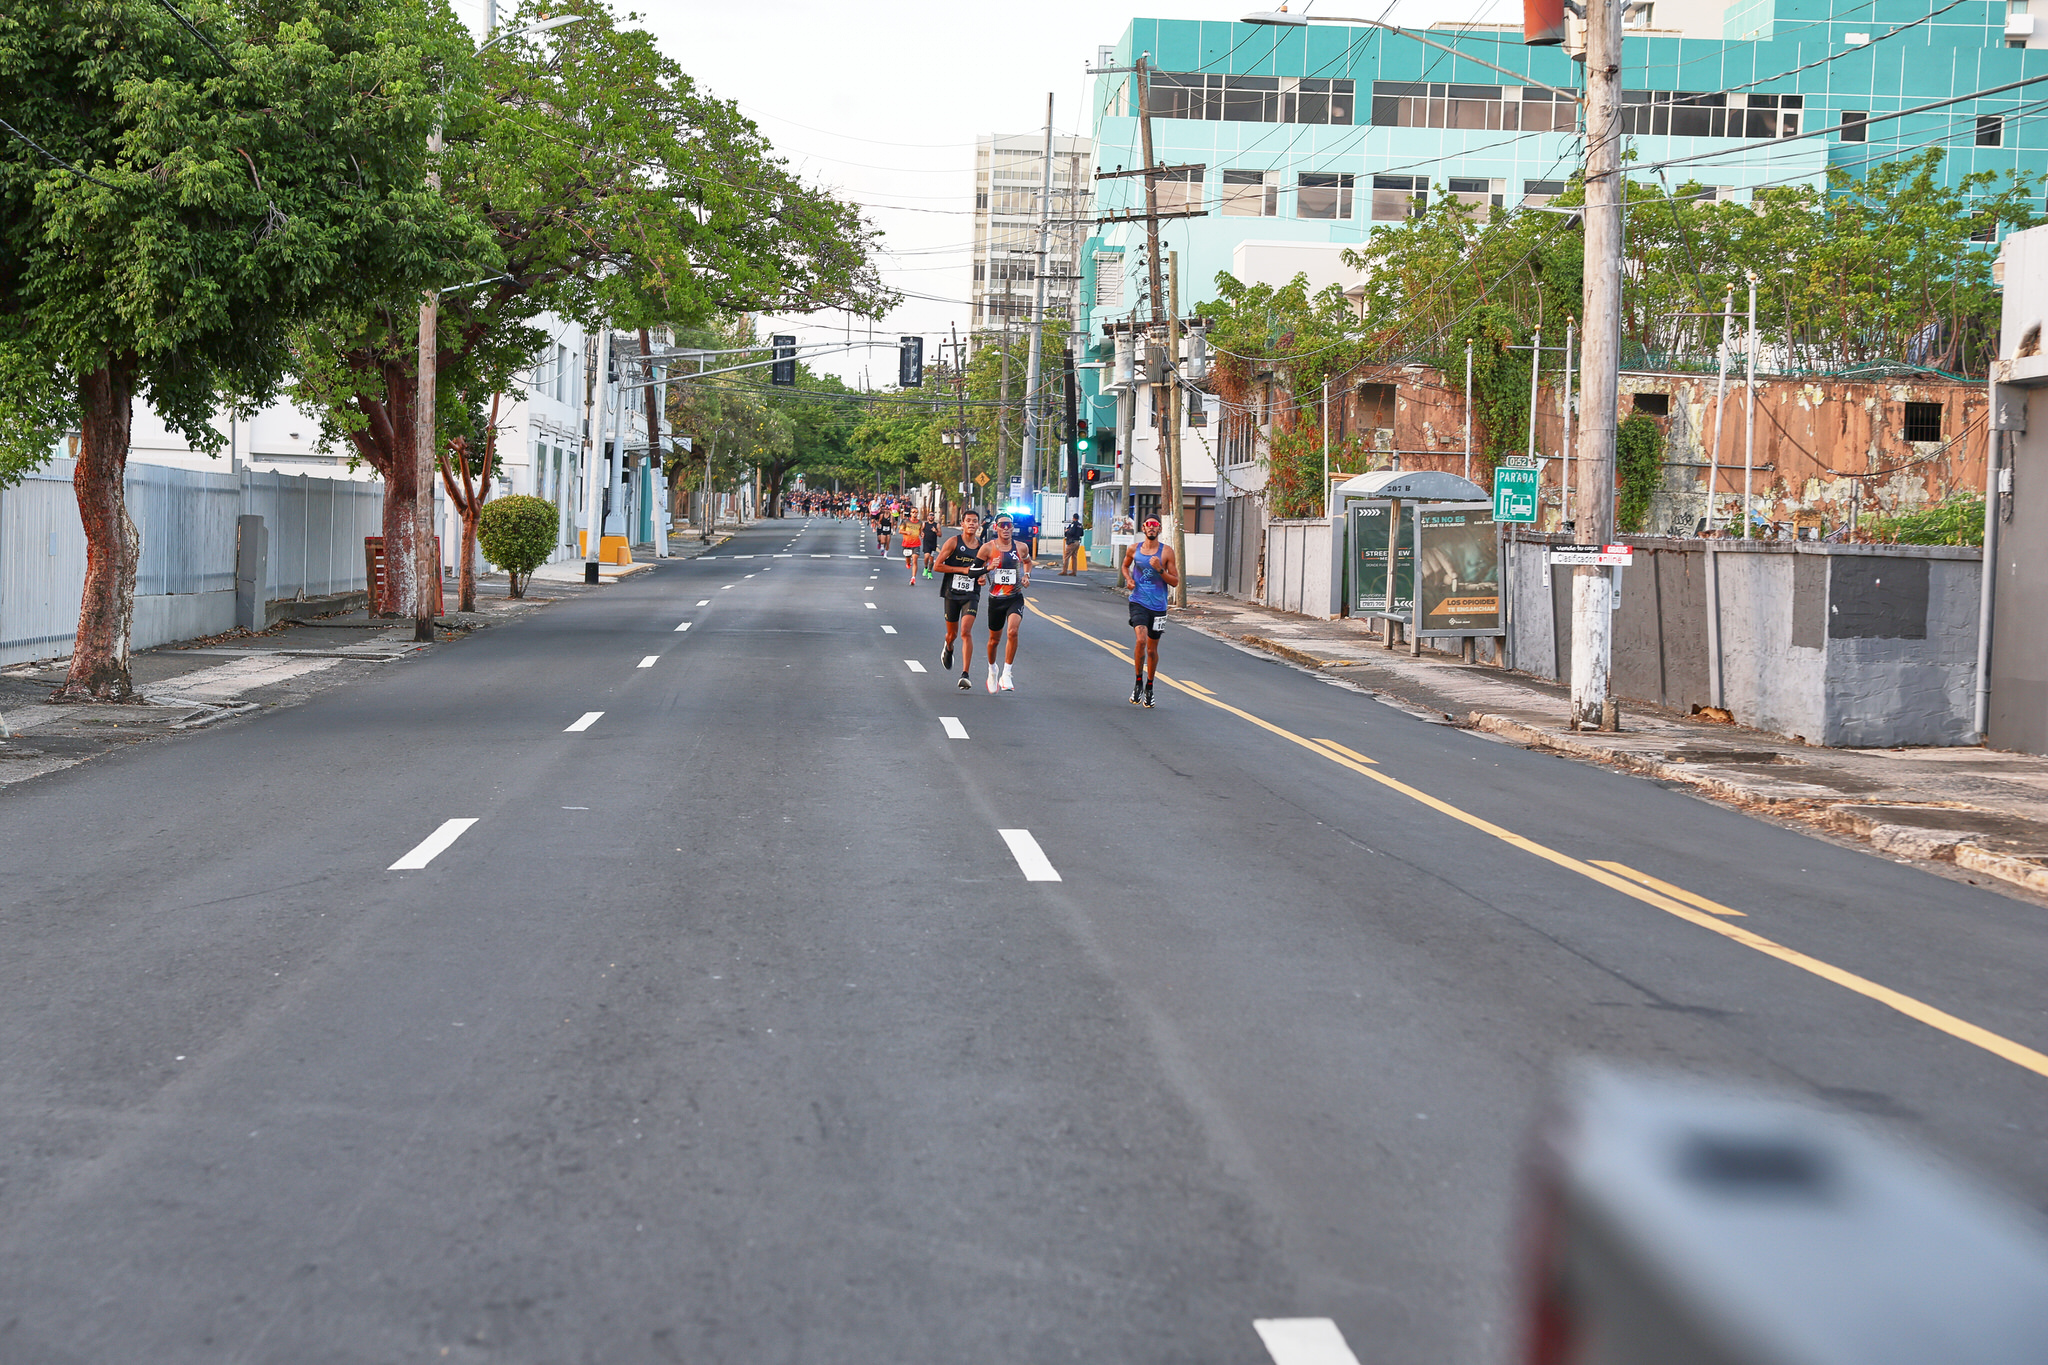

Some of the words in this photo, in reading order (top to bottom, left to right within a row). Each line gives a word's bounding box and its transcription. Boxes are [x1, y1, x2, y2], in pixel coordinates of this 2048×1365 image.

[1499, 471, 1534, 483] PARADA
[1001, 575, 1010, 583] 95
[958, 582, 970, 590] 158
